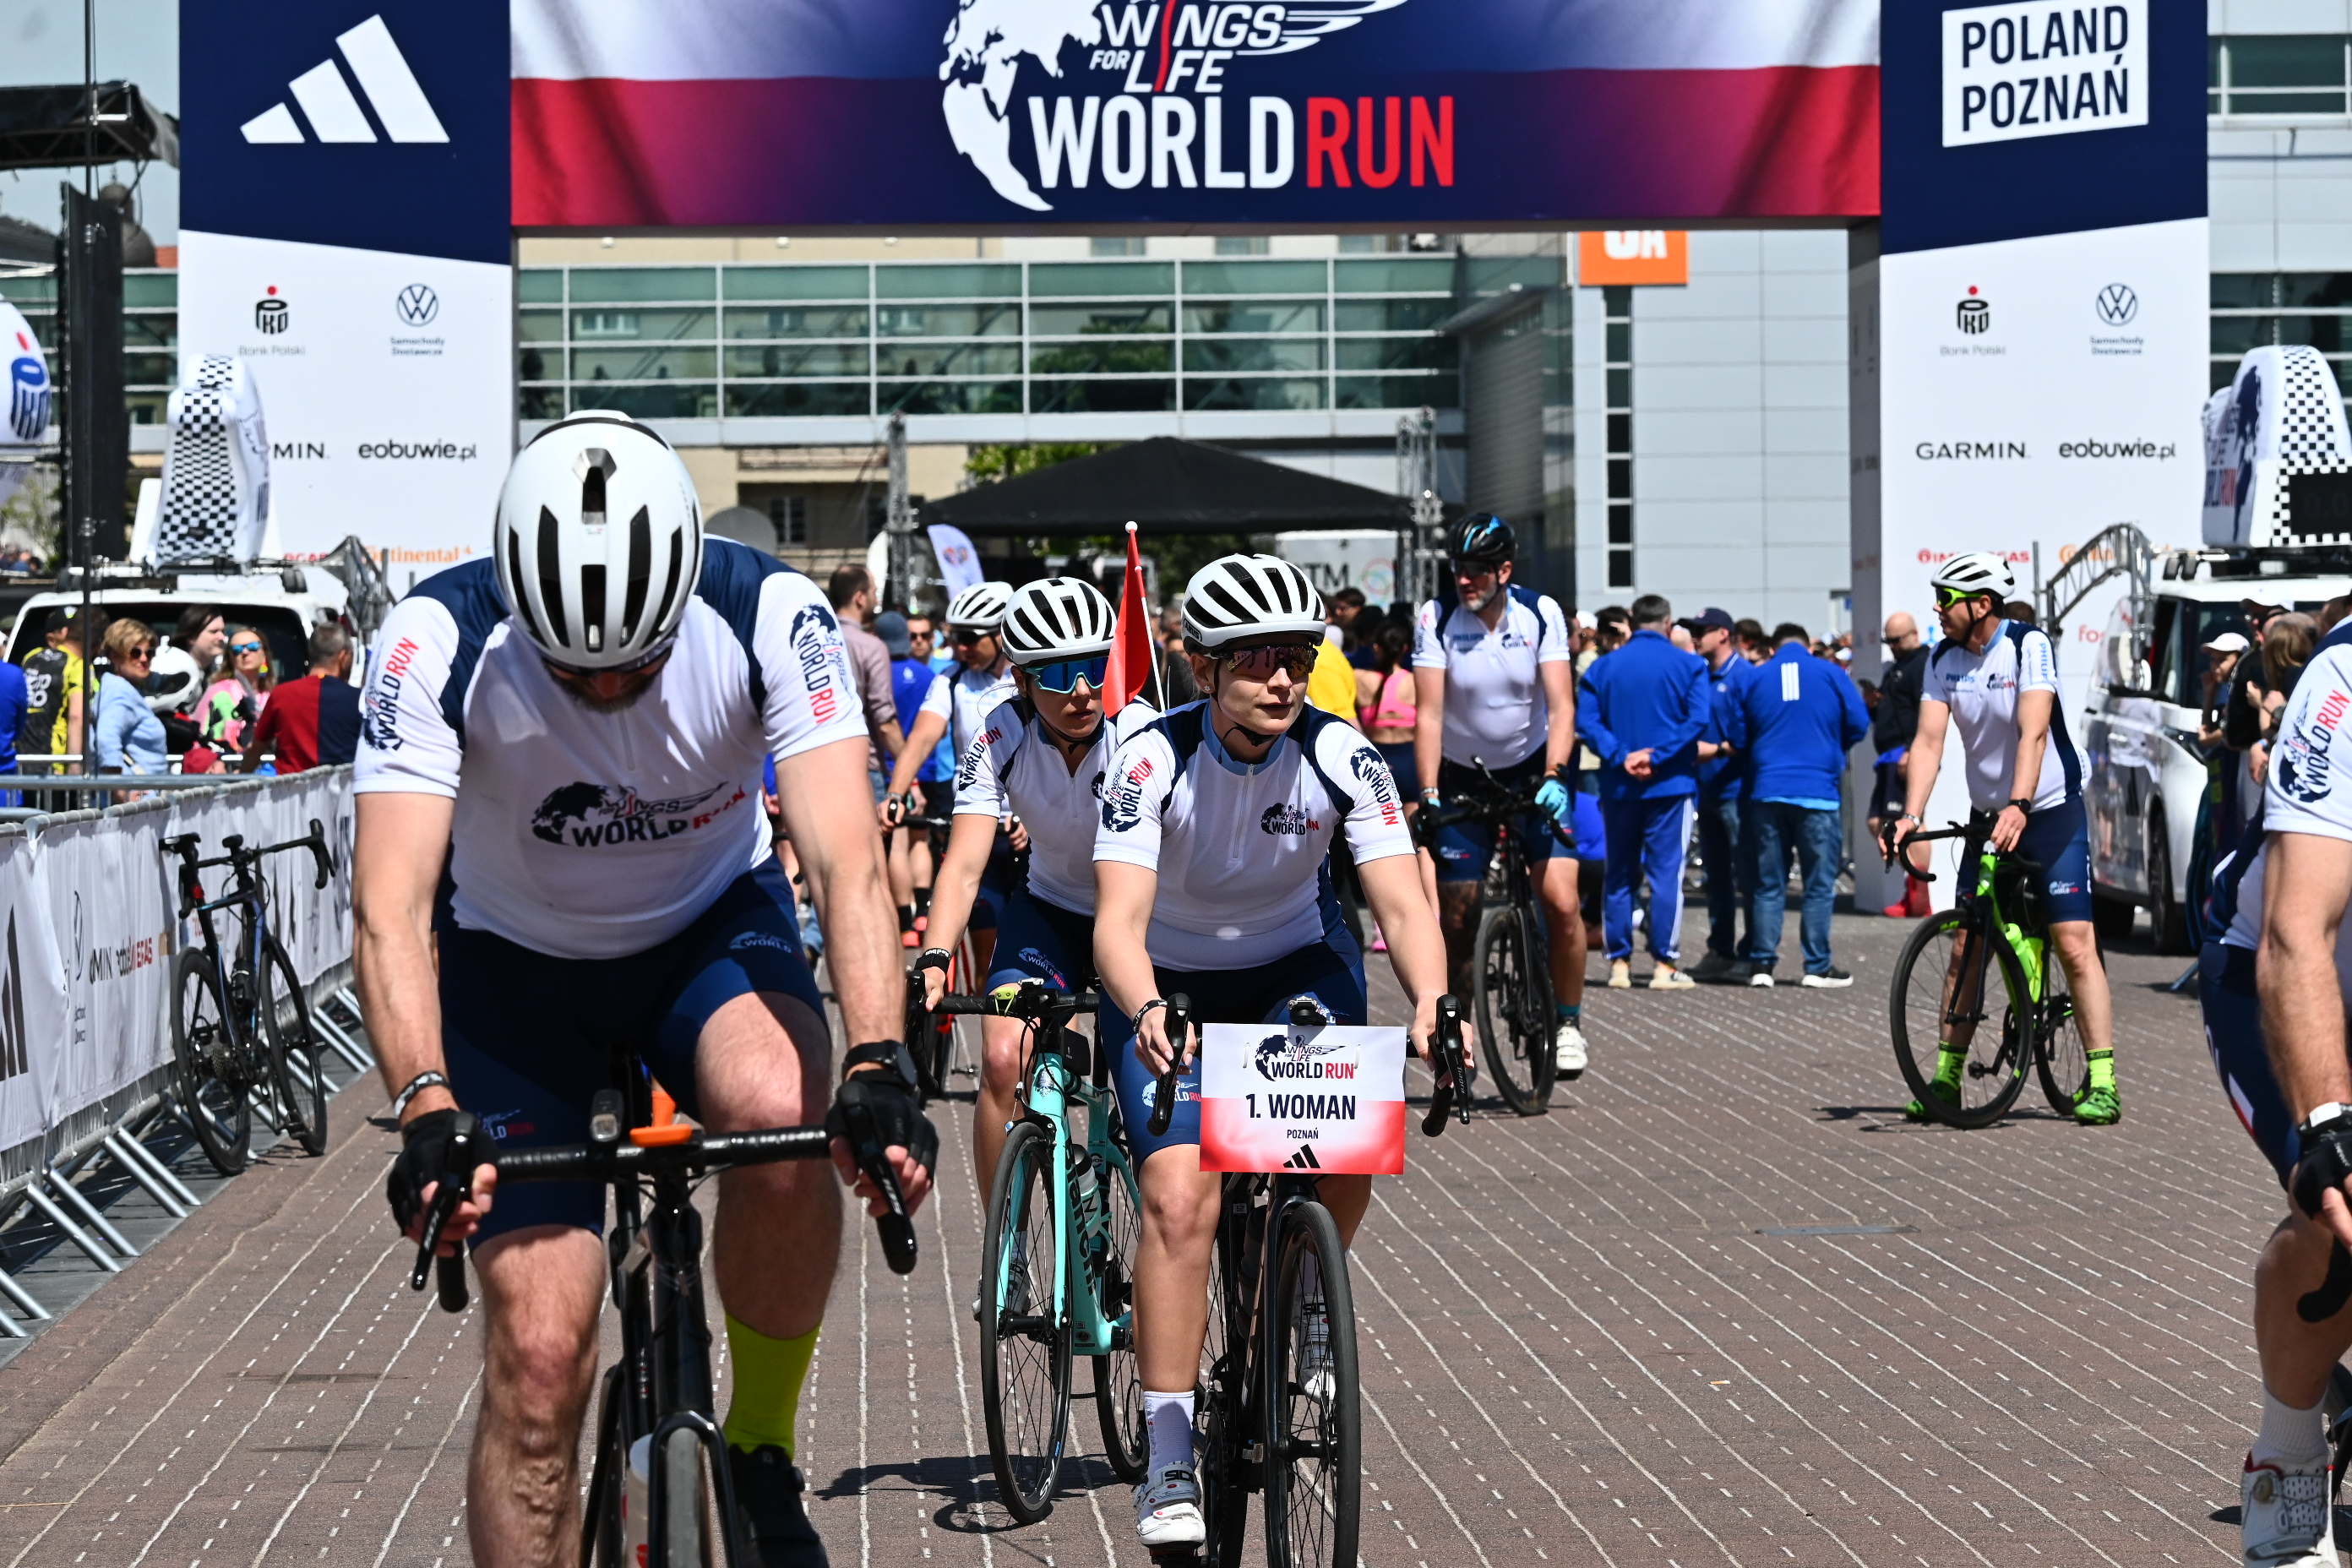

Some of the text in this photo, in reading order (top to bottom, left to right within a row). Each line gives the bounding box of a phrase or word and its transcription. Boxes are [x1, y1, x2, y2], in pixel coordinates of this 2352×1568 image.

[1102, 0, 1286, 48] WINGS
[1963, 5, 2128, 68] POLAND
[1090, 50, 1233, 93] FOR LIFE
[1963, 53, 2128, 132] POZNAŃ
[1027, 95, 1454, 190] WORLD RUN
[239, 345, 306, 356] Bank Polski
[1940, 345, 2006, 356] Bank Polski
[273, 443, 326, 459] MIN
[358, 439, 476, 461] eobuwie.pl
[1915, 442, 2026, 460] GARMIN
[2059, 438, 2175, 461] eobuwie.pl
[798, 627, 830, 692] WORLD
[377, 636, 420, 741] WORLD RUN
[2316, 689, 2351, 731] RUN
[963, 726, 1003, 781] WORLD RUN
[1129, 757, 1154, 785] RUN
[572, 816, 689, 847] WORLD
[1271, 820, 1306, 836] WORLD
[1028, 955, 1054, 977] WORLD
[1287, 1046, 1323, 1055] WINGS
[1291, 1054, 1312, 1062] LIFE
[1271, 1061, 1354, 1080] WORLD RUN
[1245, 1094, 1356, 1120] 1. WOMAN
[1287, 1128, 1319, 1140] POZNAŃ
